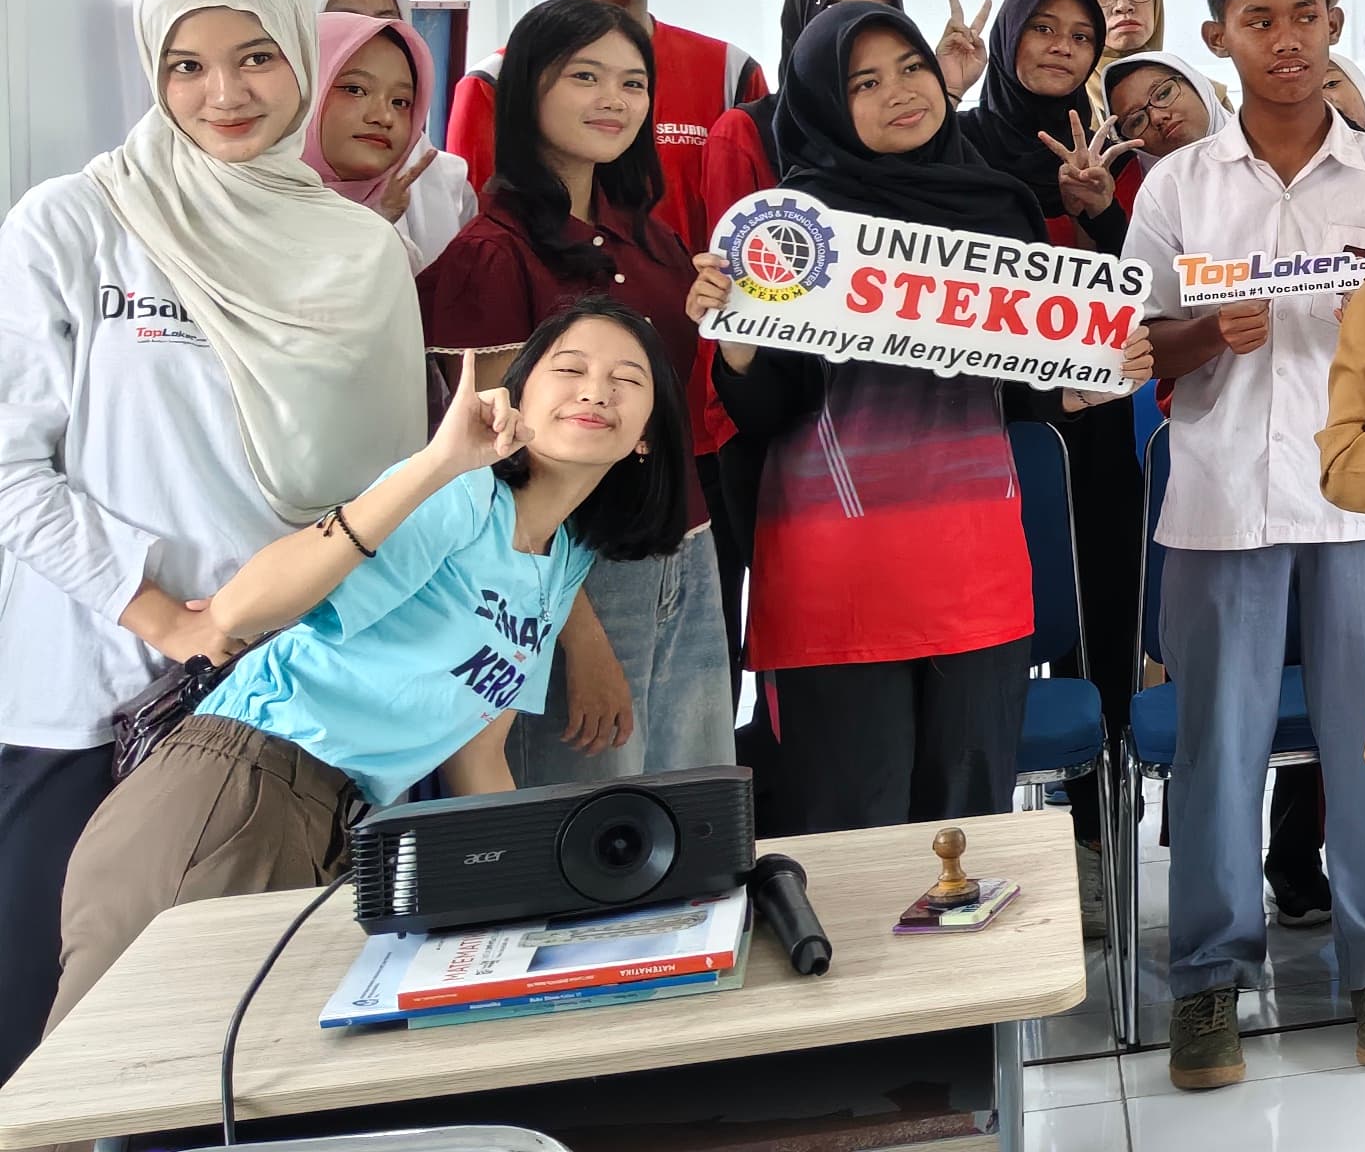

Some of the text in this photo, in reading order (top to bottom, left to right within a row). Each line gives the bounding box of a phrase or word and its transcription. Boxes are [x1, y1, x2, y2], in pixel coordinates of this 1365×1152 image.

[856, 223, 1145, 296] UNIVERSITAS
[739, 279, 803, 302] STEKOM
[846, 266, 1136, 350] STEKOM
[1184, 289, 1246, 303] Indonesia
[1249, 286, 1264, 297] #1
[1267, 281, 1334, 294] Vocational
[1338, 278, 1360, 288] Job
[710, 309, 1112, 384] Kuliahnya Menyenangkan
[449, 644, 526, 709] KERJ
[463, 850, 507, 865] acer
[619, 964, 675, 977] MATEMATIKA
